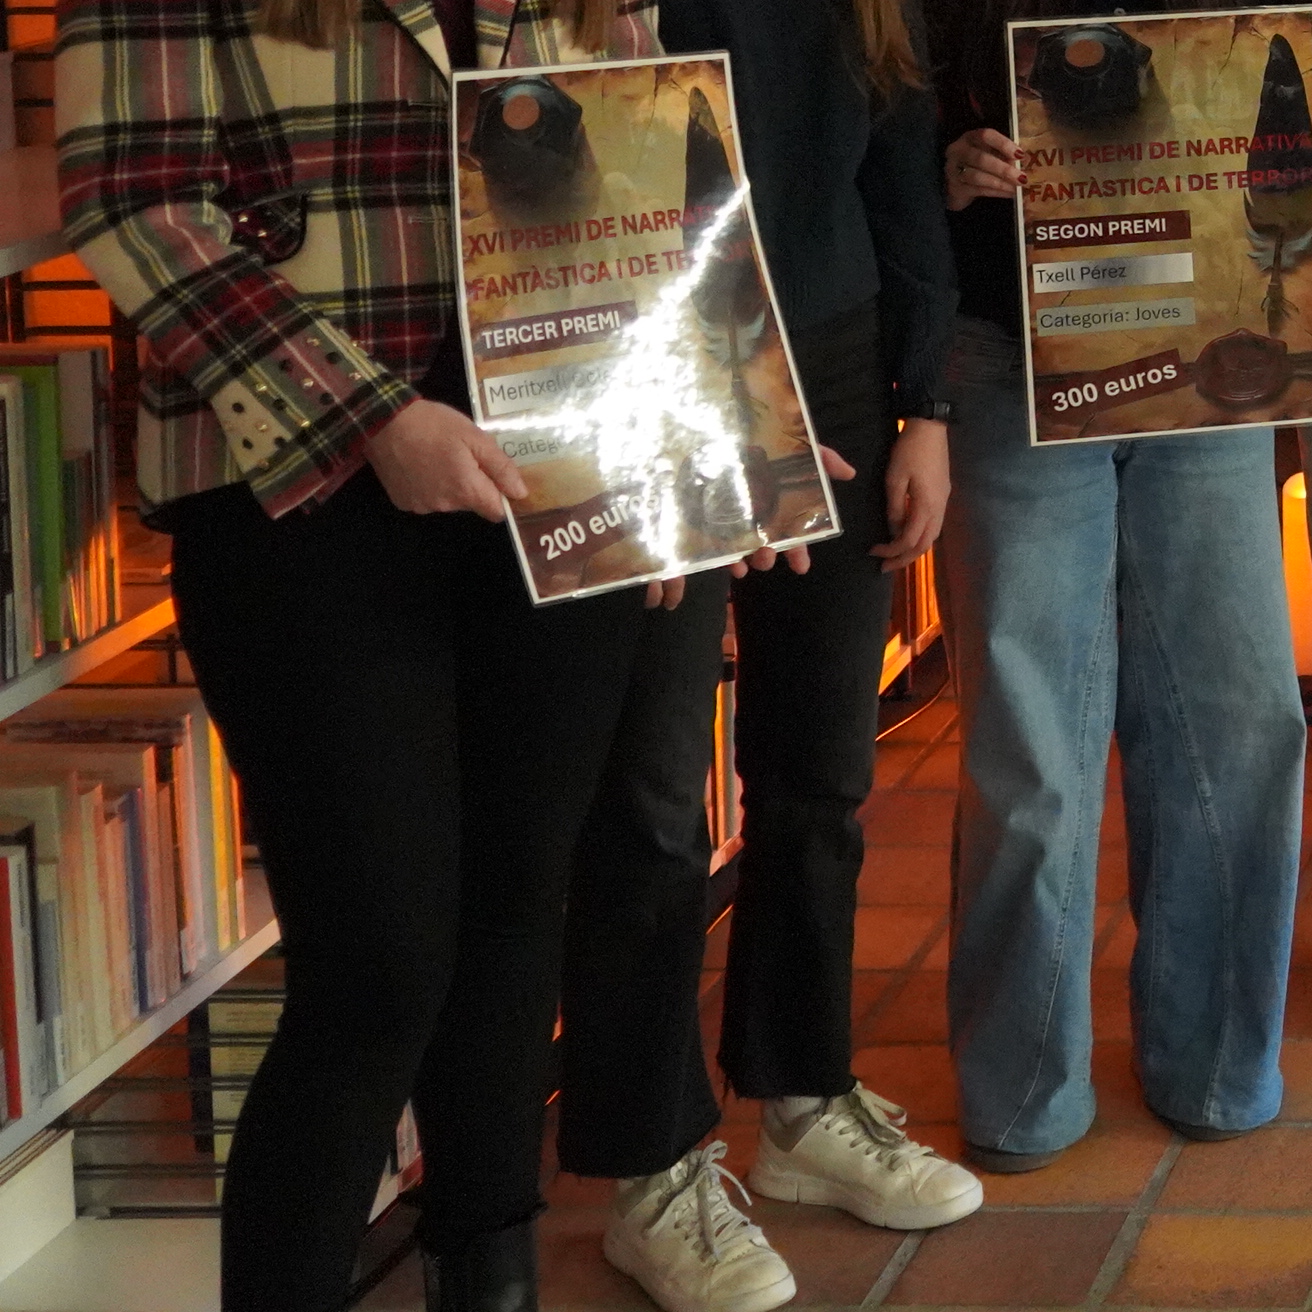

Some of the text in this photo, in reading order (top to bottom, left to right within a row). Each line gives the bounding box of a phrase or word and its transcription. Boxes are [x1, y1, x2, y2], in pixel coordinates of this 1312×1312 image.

[1026, 148, 1066, 168] XVI
[1071, 143, 1143, 166] PREMI
[1149, 141, 1181, 159] DE
[1029, 175, 1170, 203] FANTÀSTICA
[1174, 175, 1182, 193] I
[1188, 173, 1219, 192] DE
[468, 228, 506, 259] XVI
[510, 220, 581, 252] PREMI
[587, 215, 618, 240] DE
[1036, 217, 1168, 241] SEGON PREMI
[468, 257, 611, 302] FANTÀSTICA
[614, 259, 626, 280] I
[628, 254, 660, 278] DE
[1036, 263, 1127, 284] Txell Pérez
[482, 310, 622, 350] TERCER PREMI
[1040, 304, 1181, 331] Categoria: Joves
[489, 370, 568, 404] Meritxell
[1051, 362, 1178, 413] 300 euros
[539, 520, 587, 562] 200
